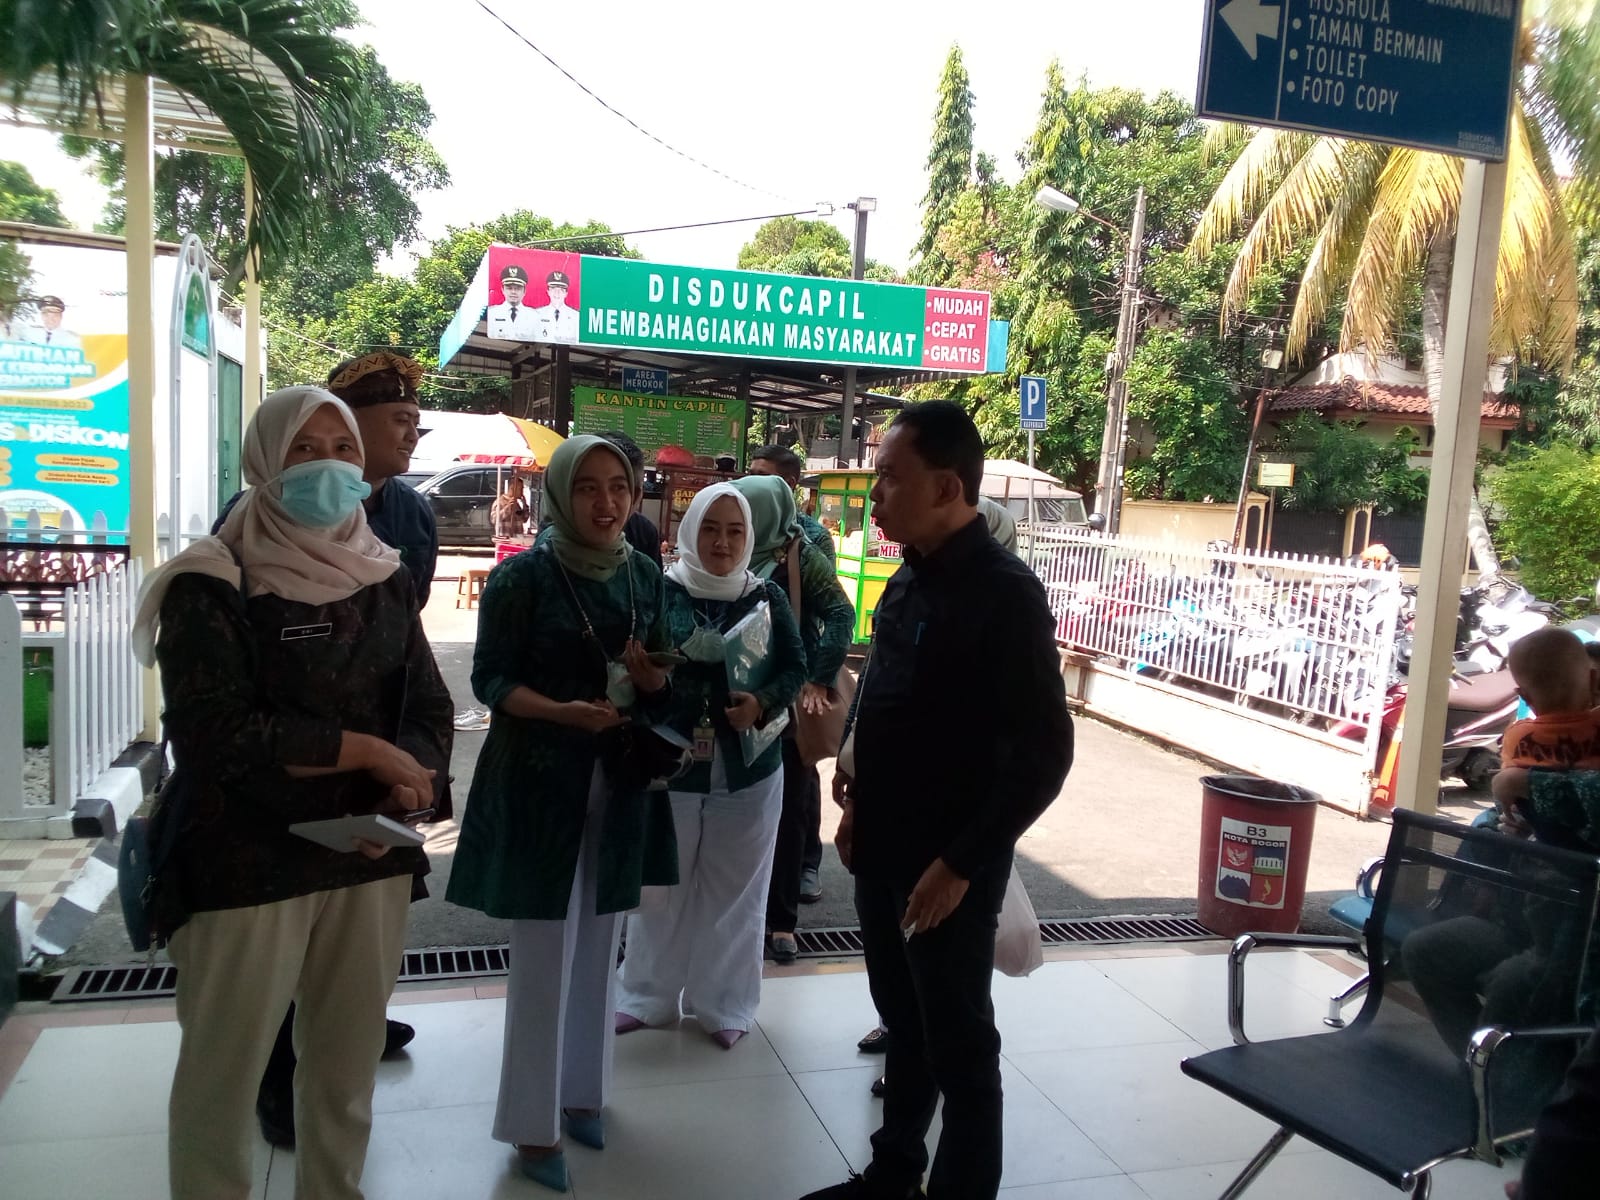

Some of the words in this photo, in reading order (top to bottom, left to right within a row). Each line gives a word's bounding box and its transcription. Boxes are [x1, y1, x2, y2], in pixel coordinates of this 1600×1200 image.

[1308, 14, 1364, 49] TAMAN
[1373, 26, 1443, 64] BERMAIN
[1305, 44, 1367, 79] TOILET
[1301, 75, 1345, 106] FOTO
[1355, 84, 1399, 115] COPY
[648, 273, 865, 320] DISDUKCAPIL
[933, 297, 984, 317] MUDAH
[588, 307, 775, 347] MEMBAHAGIAKAN
[784, 323, 917, 358] MASYARAKAT
[931, 321, 976, 340] CEPAT
[930, 345, 981, 364] GRATIS
[626, 378, 664, 389] MEROKOK
[635, 370, 656, 380] AREA
[595, 391, 668, 410] KANTIN
[673, 400, 727, 414] CAPIL
[1027, 380, 1040, 416] P
[29, 423, 129, 451] DISKON
[674, 489, 697, 498] GAD
[880, 545, 899, 557] MIE
[1223, 833, 1249, 844] KOTA
[1251, 839, 1285, 848] BOGOR
[1246, 826, 1267, 838] B3
